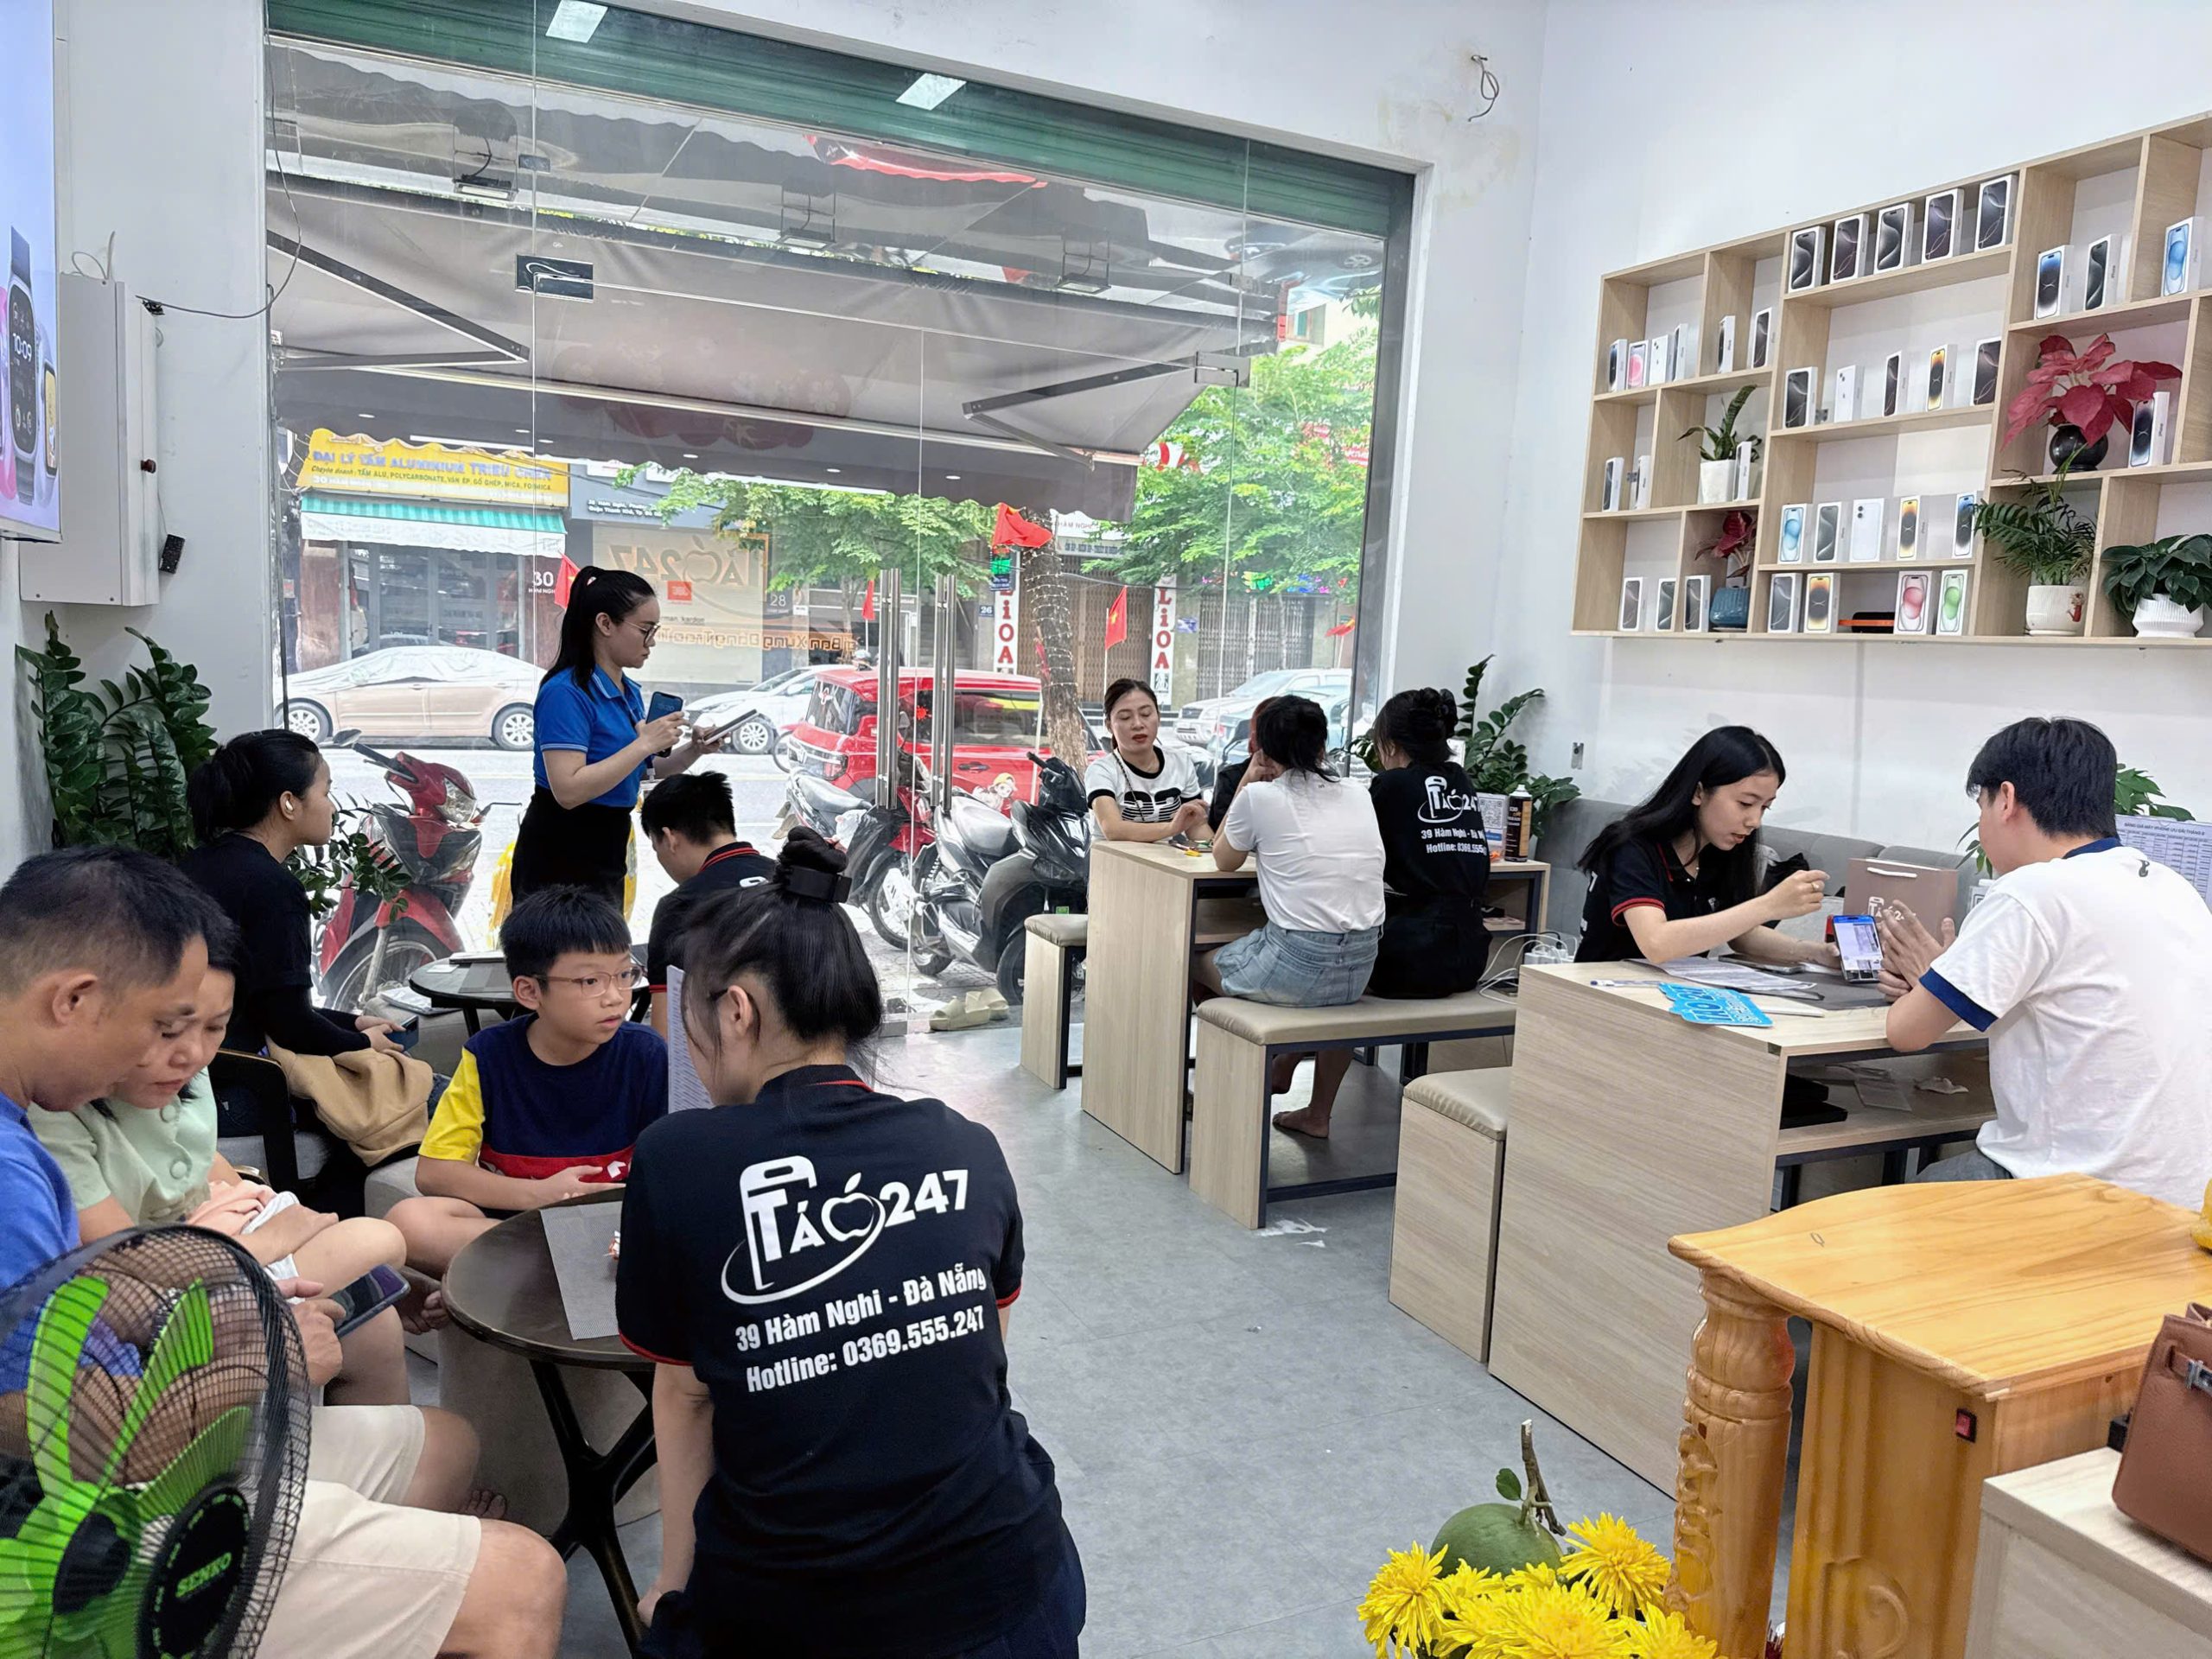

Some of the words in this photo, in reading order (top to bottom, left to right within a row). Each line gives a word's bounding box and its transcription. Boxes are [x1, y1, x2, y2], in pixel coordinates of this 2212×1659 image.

[13, 333, 32, 362] 10:09
[532, 571, 554, 587] 30
[770, 594, 786, 607] 28
[1421, 829, 1433, 840] 39
[1434, 827, 1452, 838] Hàm
[735, 1324, 761, 1352] 39
[766, 1313, 821, 1346] Hàm
[825, 1289, 884, 1327] Nghi
[903, 1276, 935, 1307] Đà
[939, 1262, 988, 1294] Nẵng
[747, 1351, 837, 1393] Hotline:
[842, 1305, 985, 1367] 0369.555.247
